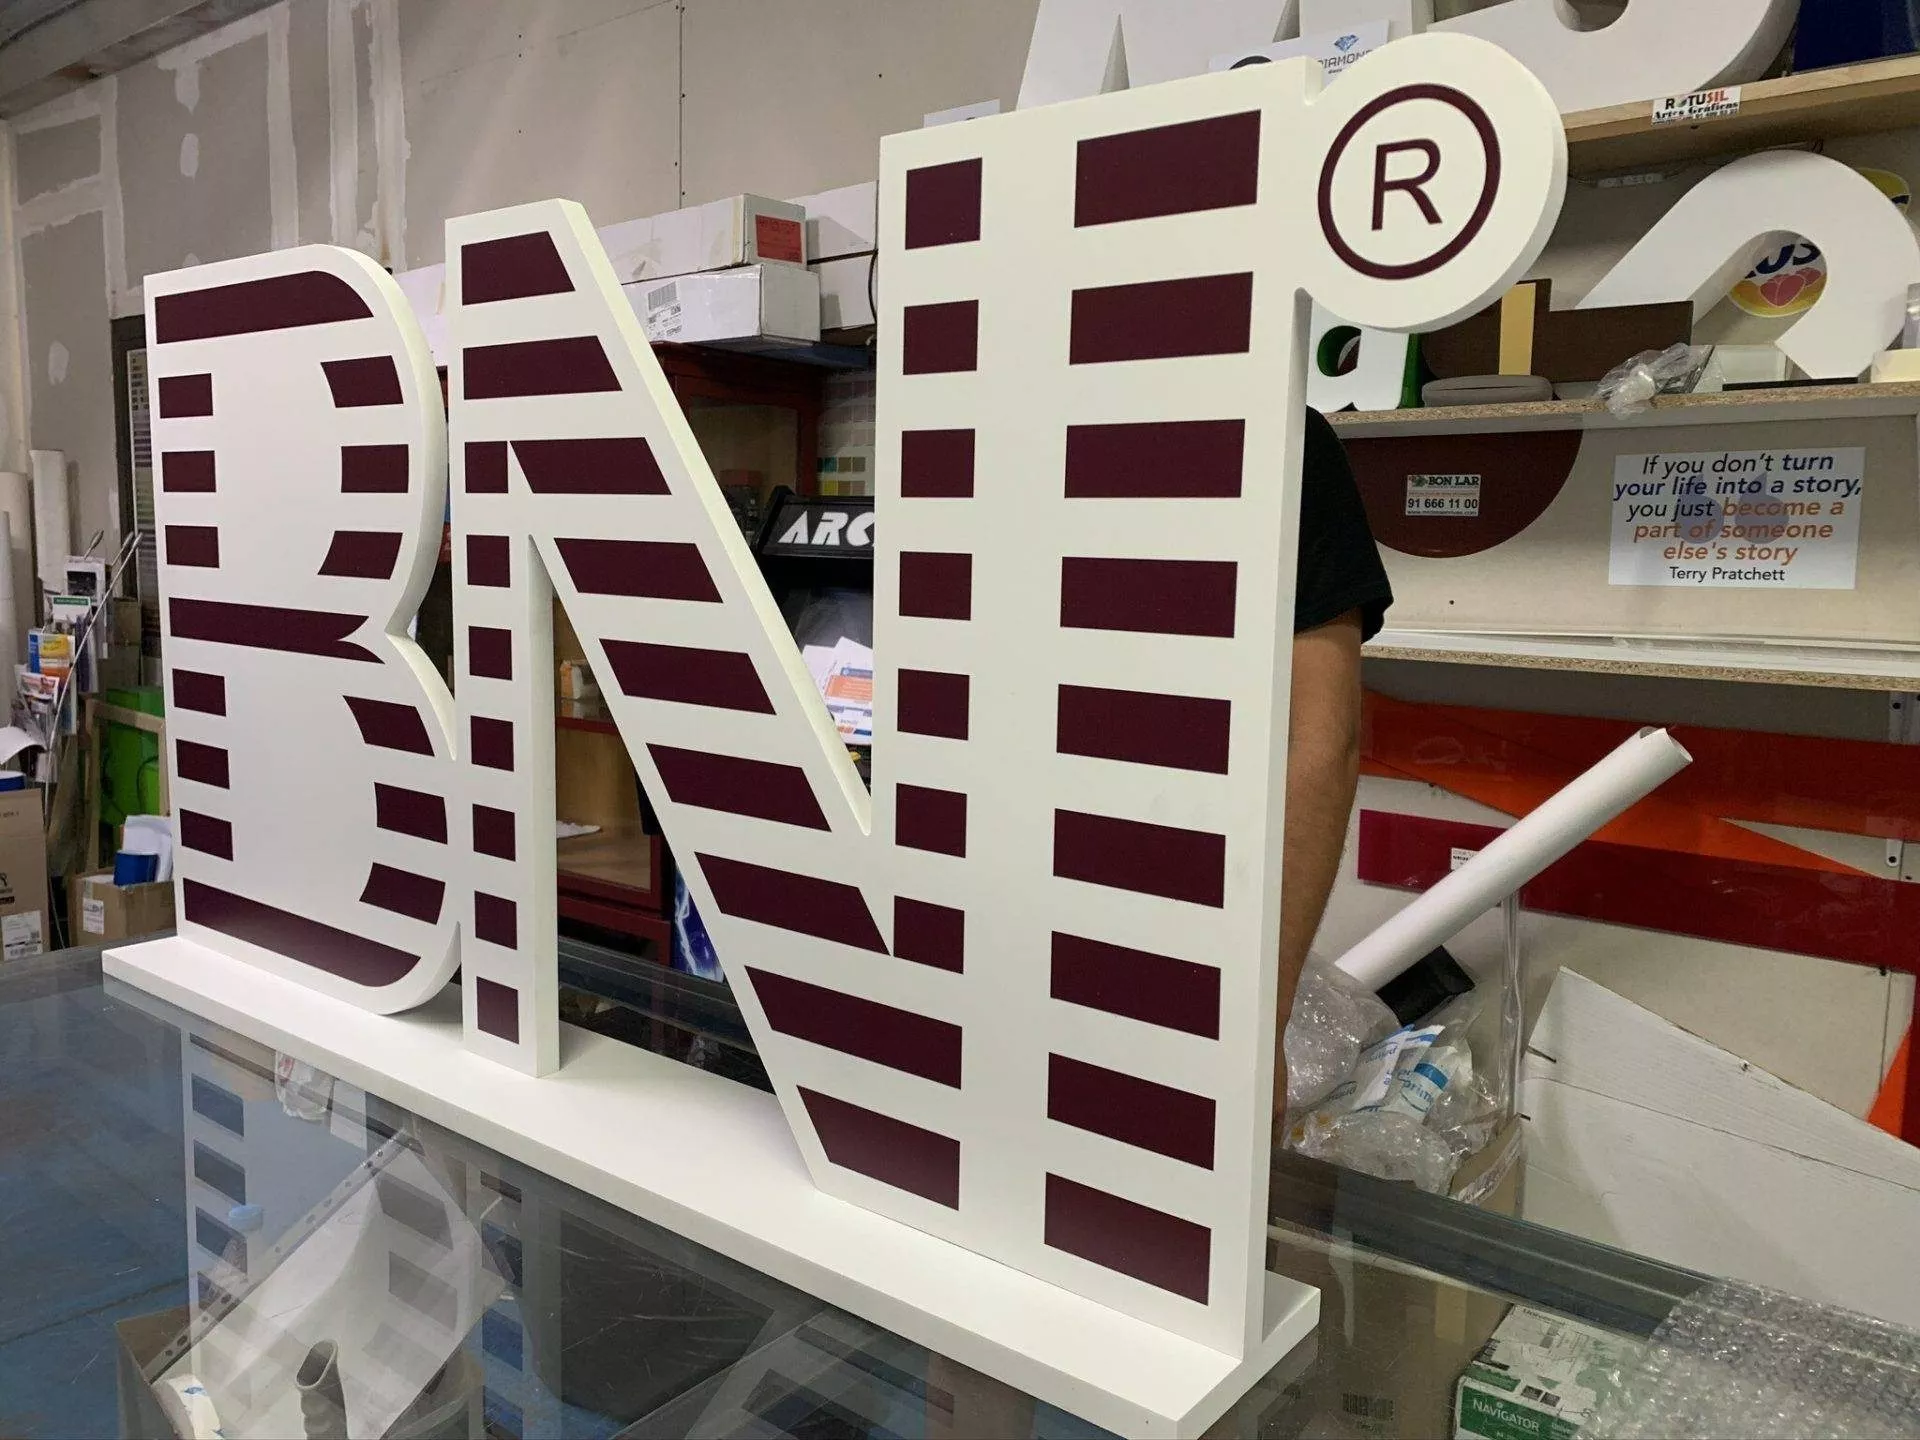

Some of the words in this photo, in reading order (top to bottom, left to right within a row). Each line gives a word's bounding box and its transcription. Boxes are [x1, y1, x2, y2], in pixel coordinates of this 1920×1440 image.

[1317, 49, 1373, 69] IAMON
[1642, 455, 1660, 475] If
[1662, 458, 1704, 480] you
[1711, 453, 1775, 473] don't
[1782, 454, 1834, 471] turn
[1428, 476, 1453, 486] BON
[1455, 476, 1480, 486] LAR
[1613, 481, 1665, 501] your
[1671, 475, 1708, 496] life
[1715, 477, 1762, 495] into
[1770, 480, 1784, 494] a
[1792, 476, 1862, 499] story,
[1407, 498, 1420, 508] 91
[1424, 498, 1445, 508] 666
[1448, 498, 1460, 508] 11
[1464, 498, 1478, 508] 00
[1626, 502, 1667, 523] you
[1671, 501, 1716, 522] just
[1723, 497, 1821, 517] become
[1829, 501, 1845, 515] a
[777, 510, 875, 547] ARC
[1634, 521, 1682, 543] part
[1688, 519, 1716, 539] of
[1719, 523, 1834, 539] someone
[1663, 542, 1728, 561] else's
[1734, 544, 1799, 566] story
[1669, 566, 1707, 583] Terry
[1711, 567, 1786, 582] Pratchett
[145, 62, 1318, 1362] BNI
[1402, 1079, 1434, 1106] prim
[1472, 1397, 1540, 1433] NAVIGATOR
